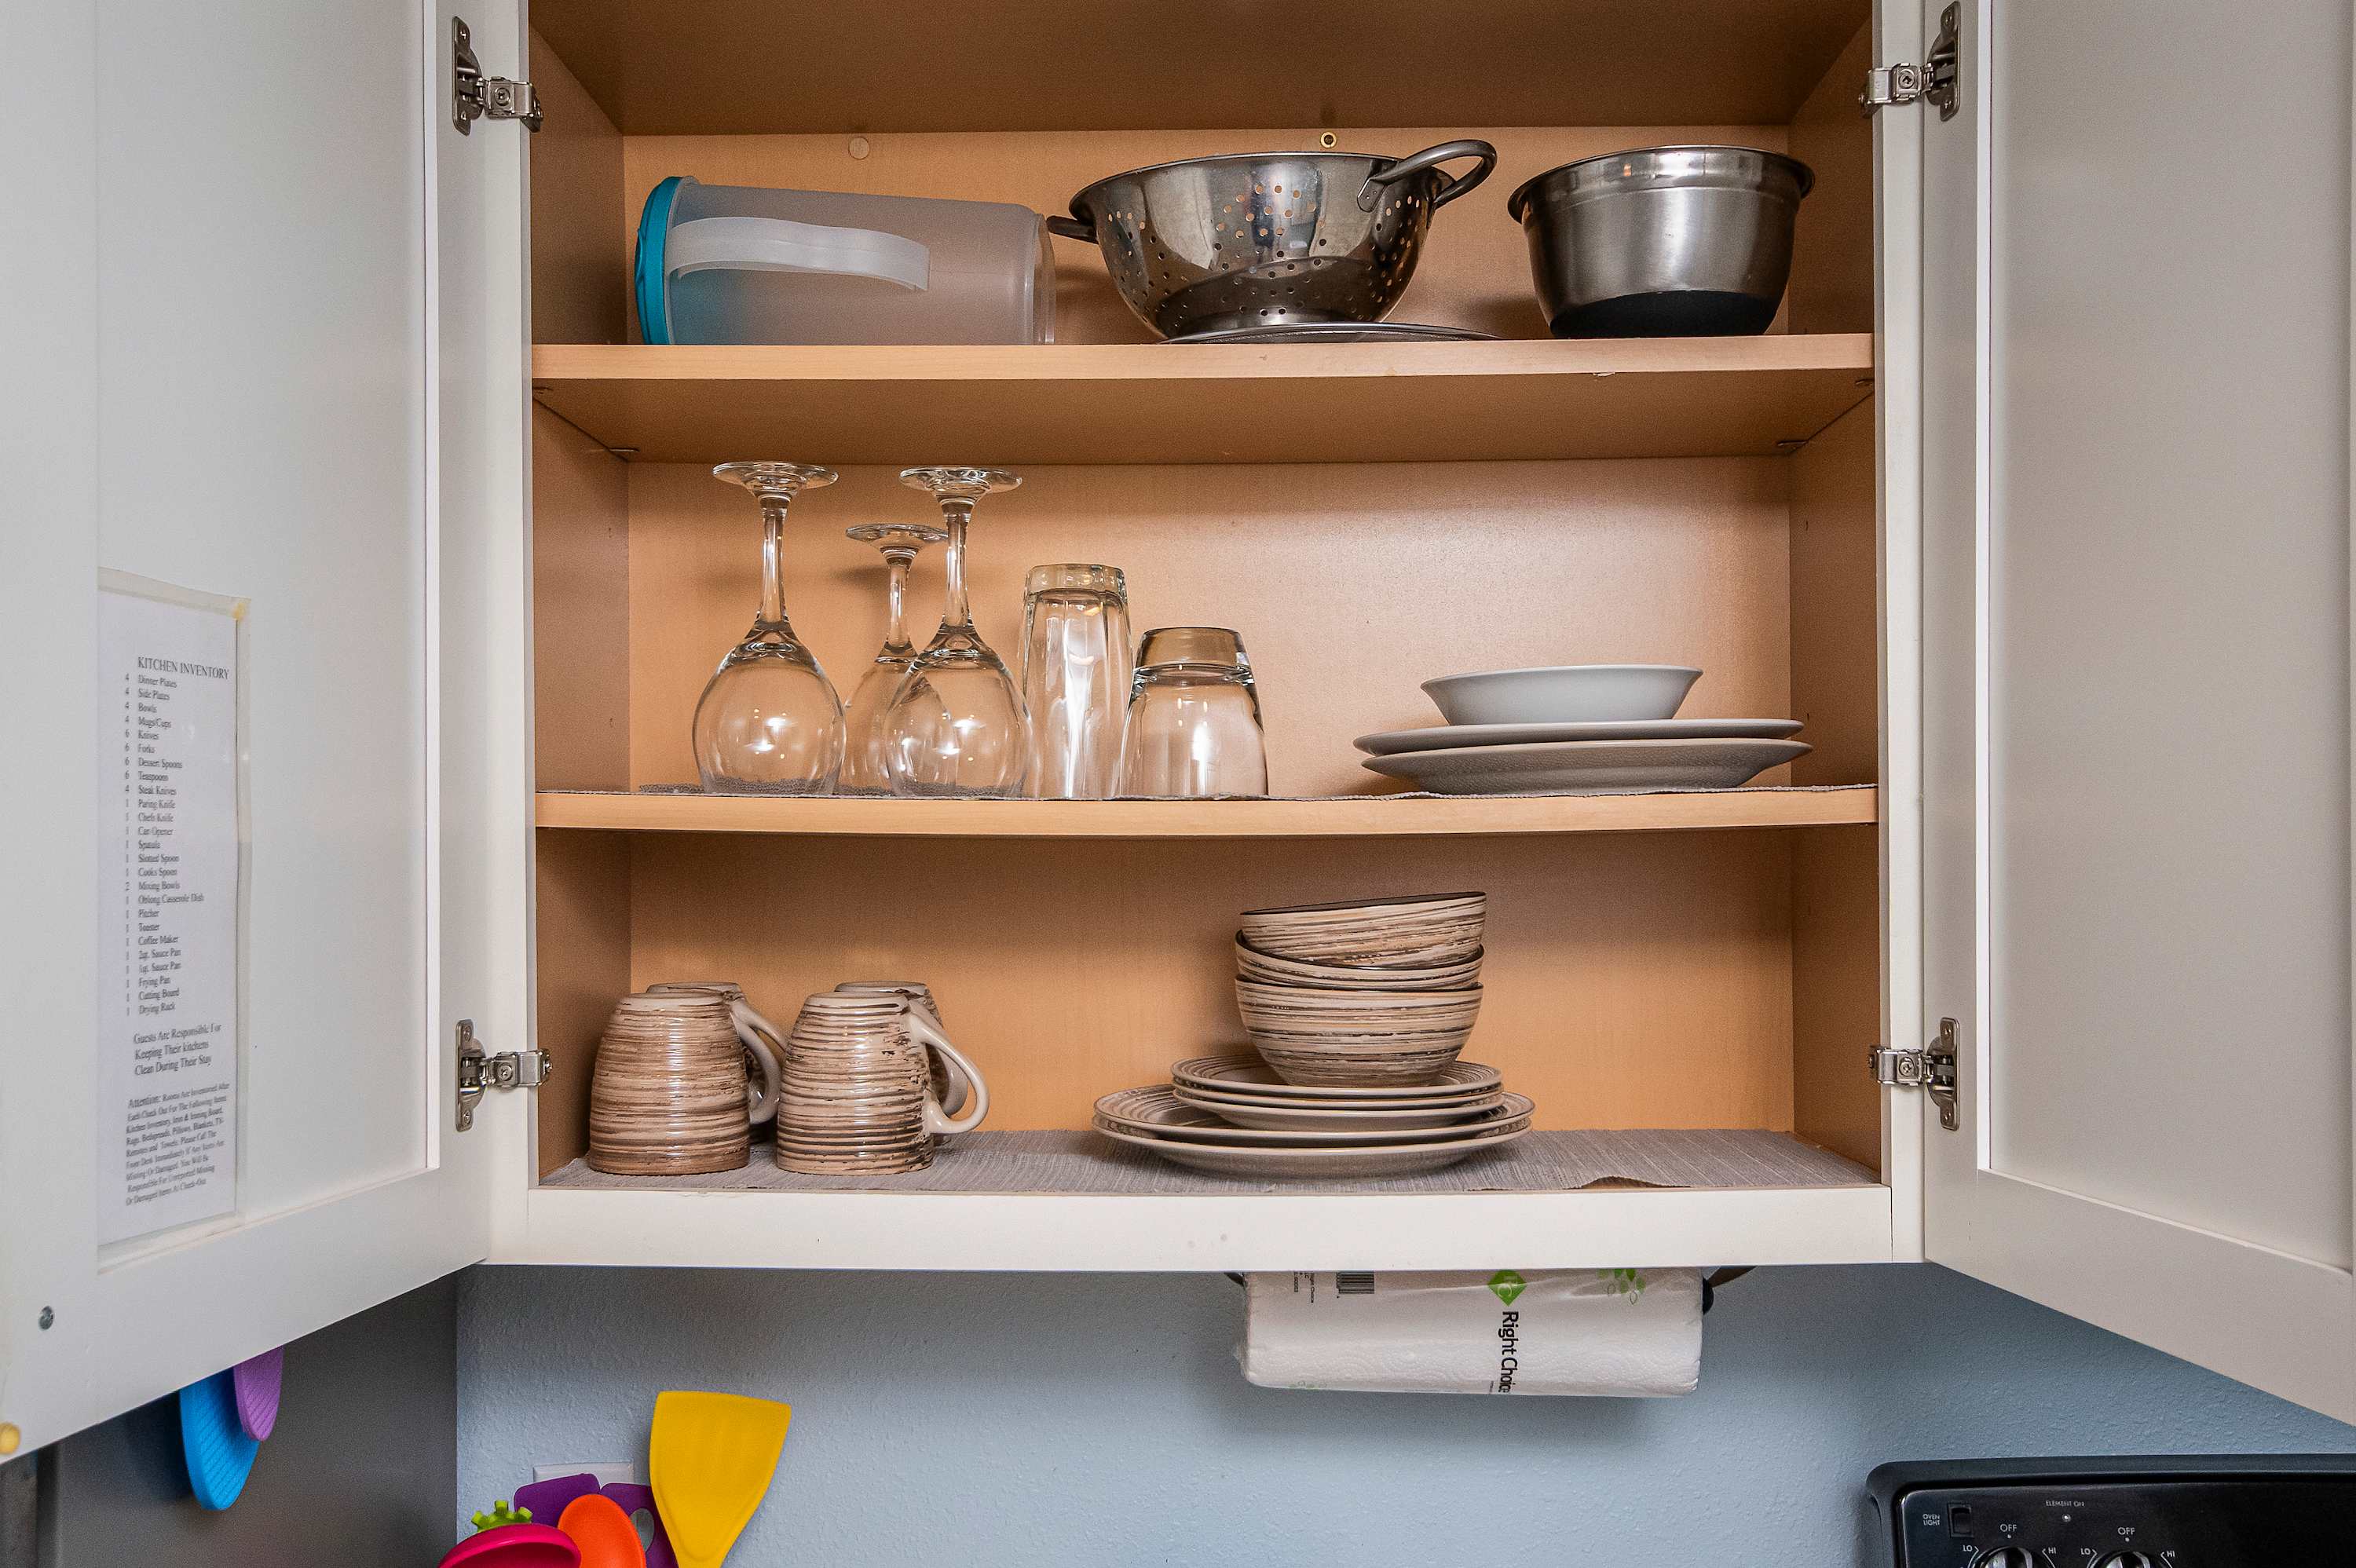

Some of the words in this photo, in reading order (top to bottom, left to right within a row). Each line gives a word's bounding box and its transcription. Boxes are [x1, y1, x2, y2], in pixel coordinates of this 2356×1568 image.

[137, 656, 178, 672] KITCHEN
[180, 662, 229, 680] INVENTORY
[138, 674, 158, 685] Dinner
[159, 677, 177, 688] Plates
[138, 688, 152, 698] Side
[138, 744, 155, 753] Forks
[161, 758, 182, 769] Spoons
[138, 770, 168, 782] Teaspoons
[159, 799, 176, 809] Knife
[161, 853, 179, 864] Spoon
[159, 867, 177, 879] Spoon
[191, 892, 204, 902] Dish
[138, 936, 158, 945] Coffee
[160, 935, 180, 944] Maker
[134, 1033, 156, 1044] Guests
[158, 1031, 170, 1040] Are
[171, 1024, 209, 1039] Responsible
[134, 1047, 163, 1060] Keeping
[164, 1044, 181, 1054] Their
[134, 1064, 154, 1076] Clean
[155, 1061, 178, 1072] During
[180, 1058, 197, 1068] Their
[1498, 1311, 1520, 1355] Right
[1498, 1357, 1518, 1393] Choice
[1999, 1523, 2018, 1532] OFF
[2117, 1526, 2135, 1535] OFF
